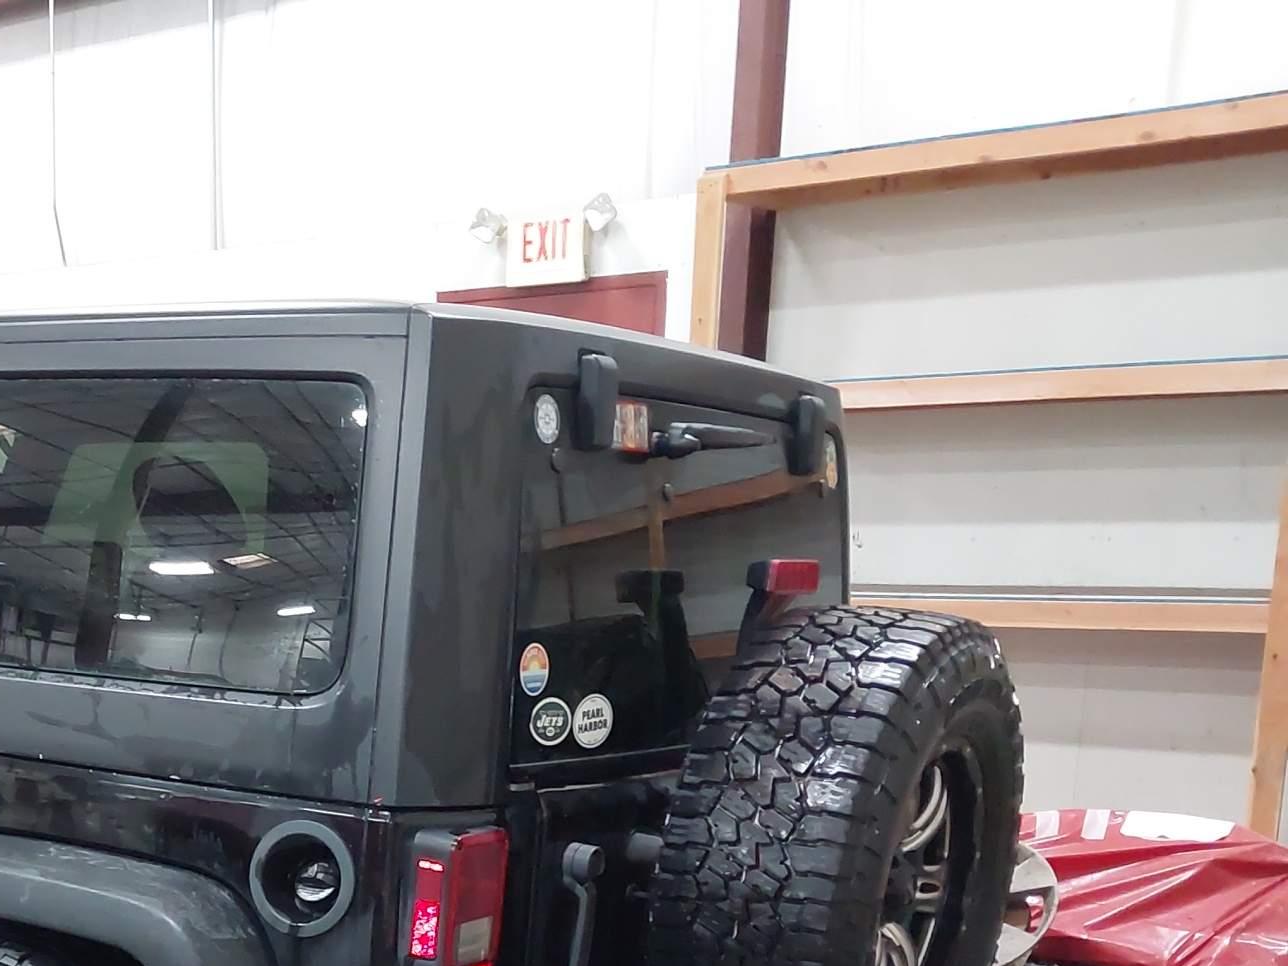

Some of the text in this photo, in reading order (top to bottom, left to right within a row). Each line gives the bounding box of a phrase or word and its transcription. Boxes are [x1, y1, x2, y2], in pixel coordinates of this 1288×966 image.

[522, 217, 571, 264] EXIT
[536, 714, 564, 728] JETS
[581, 707, 604, 721] PEARL
[577, 719, 608, 734] HARBOR
